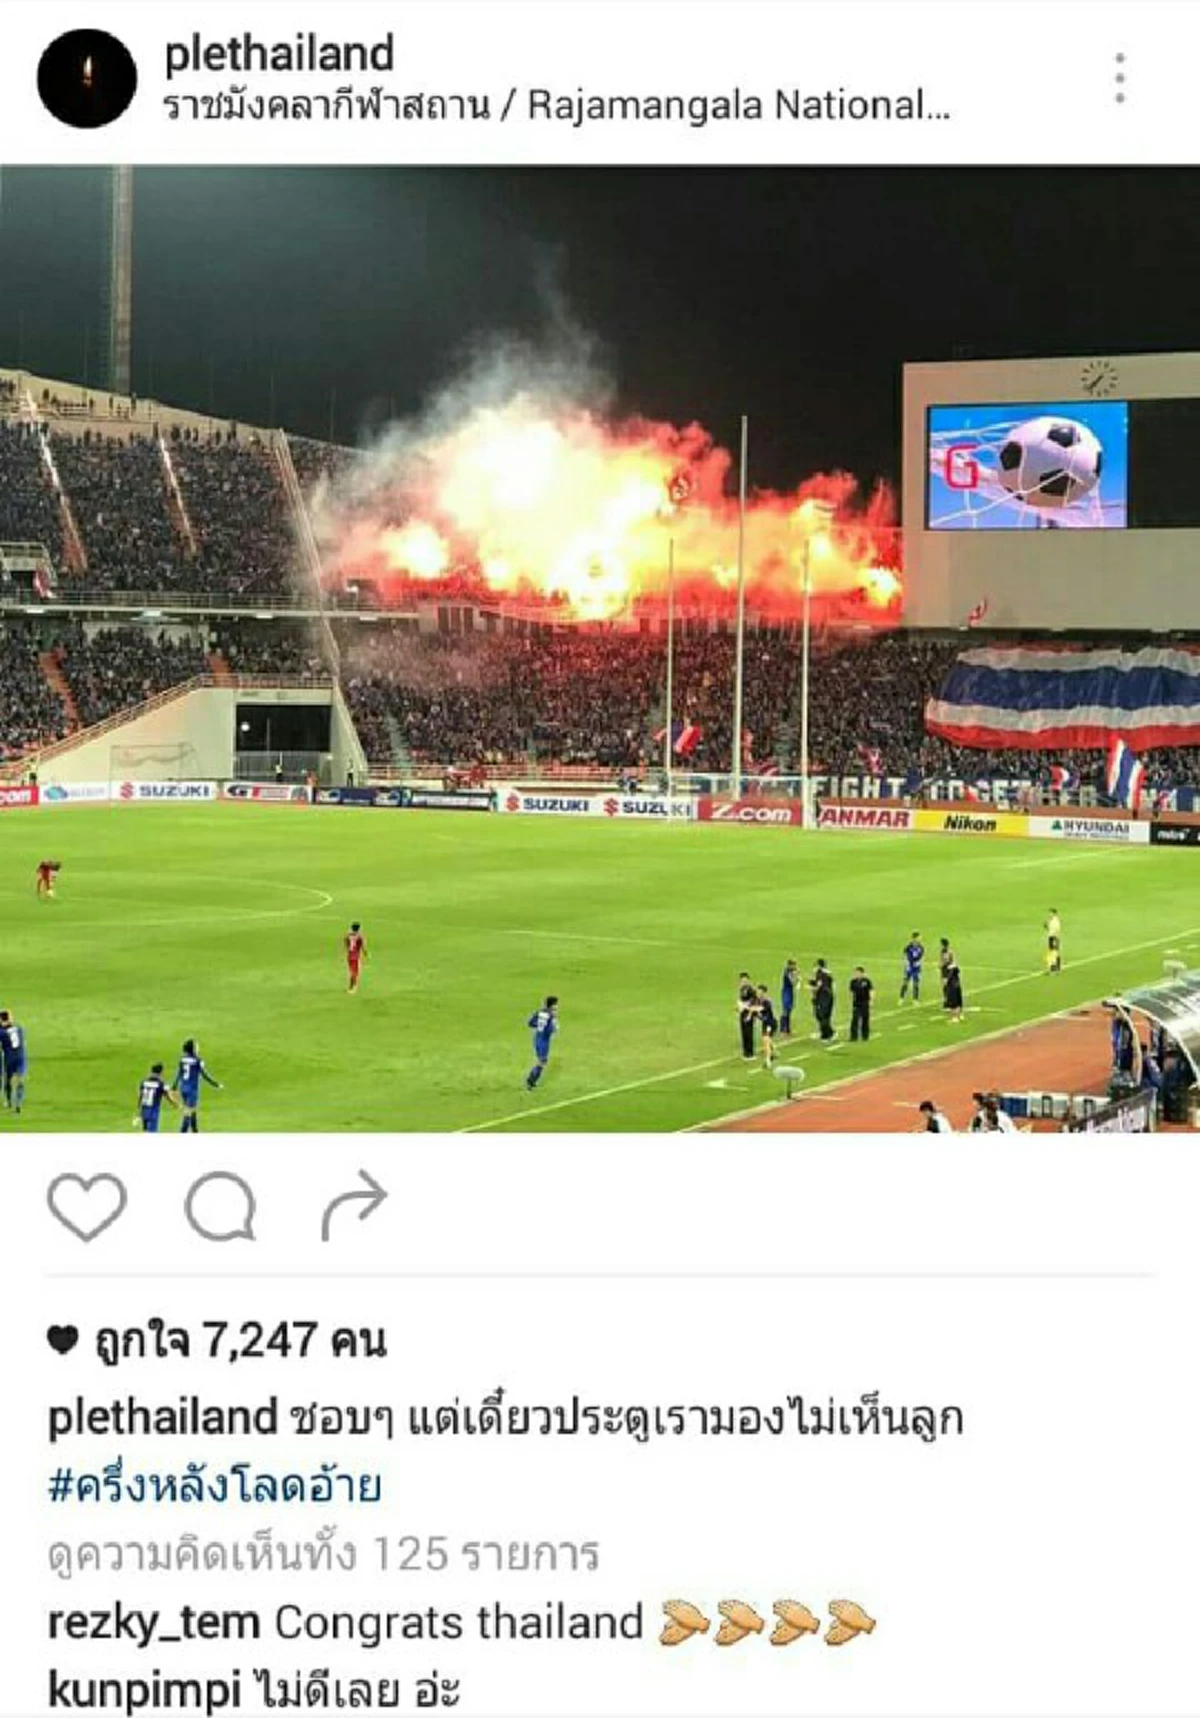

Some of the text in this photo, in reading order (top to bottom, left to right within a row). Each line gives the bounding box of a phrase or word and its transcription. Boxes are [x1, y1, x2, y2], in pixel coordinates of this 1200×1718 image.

[944, 445, 979, 488] G
[140, 785, 209, 797] SUZUKI
[523, 798, 589, 812] SUZUKI
[711, 801, 792, 820] Z.com
[820, 808, 910, 827] ANMAR
[943, 815, 997, 832] Nikon
